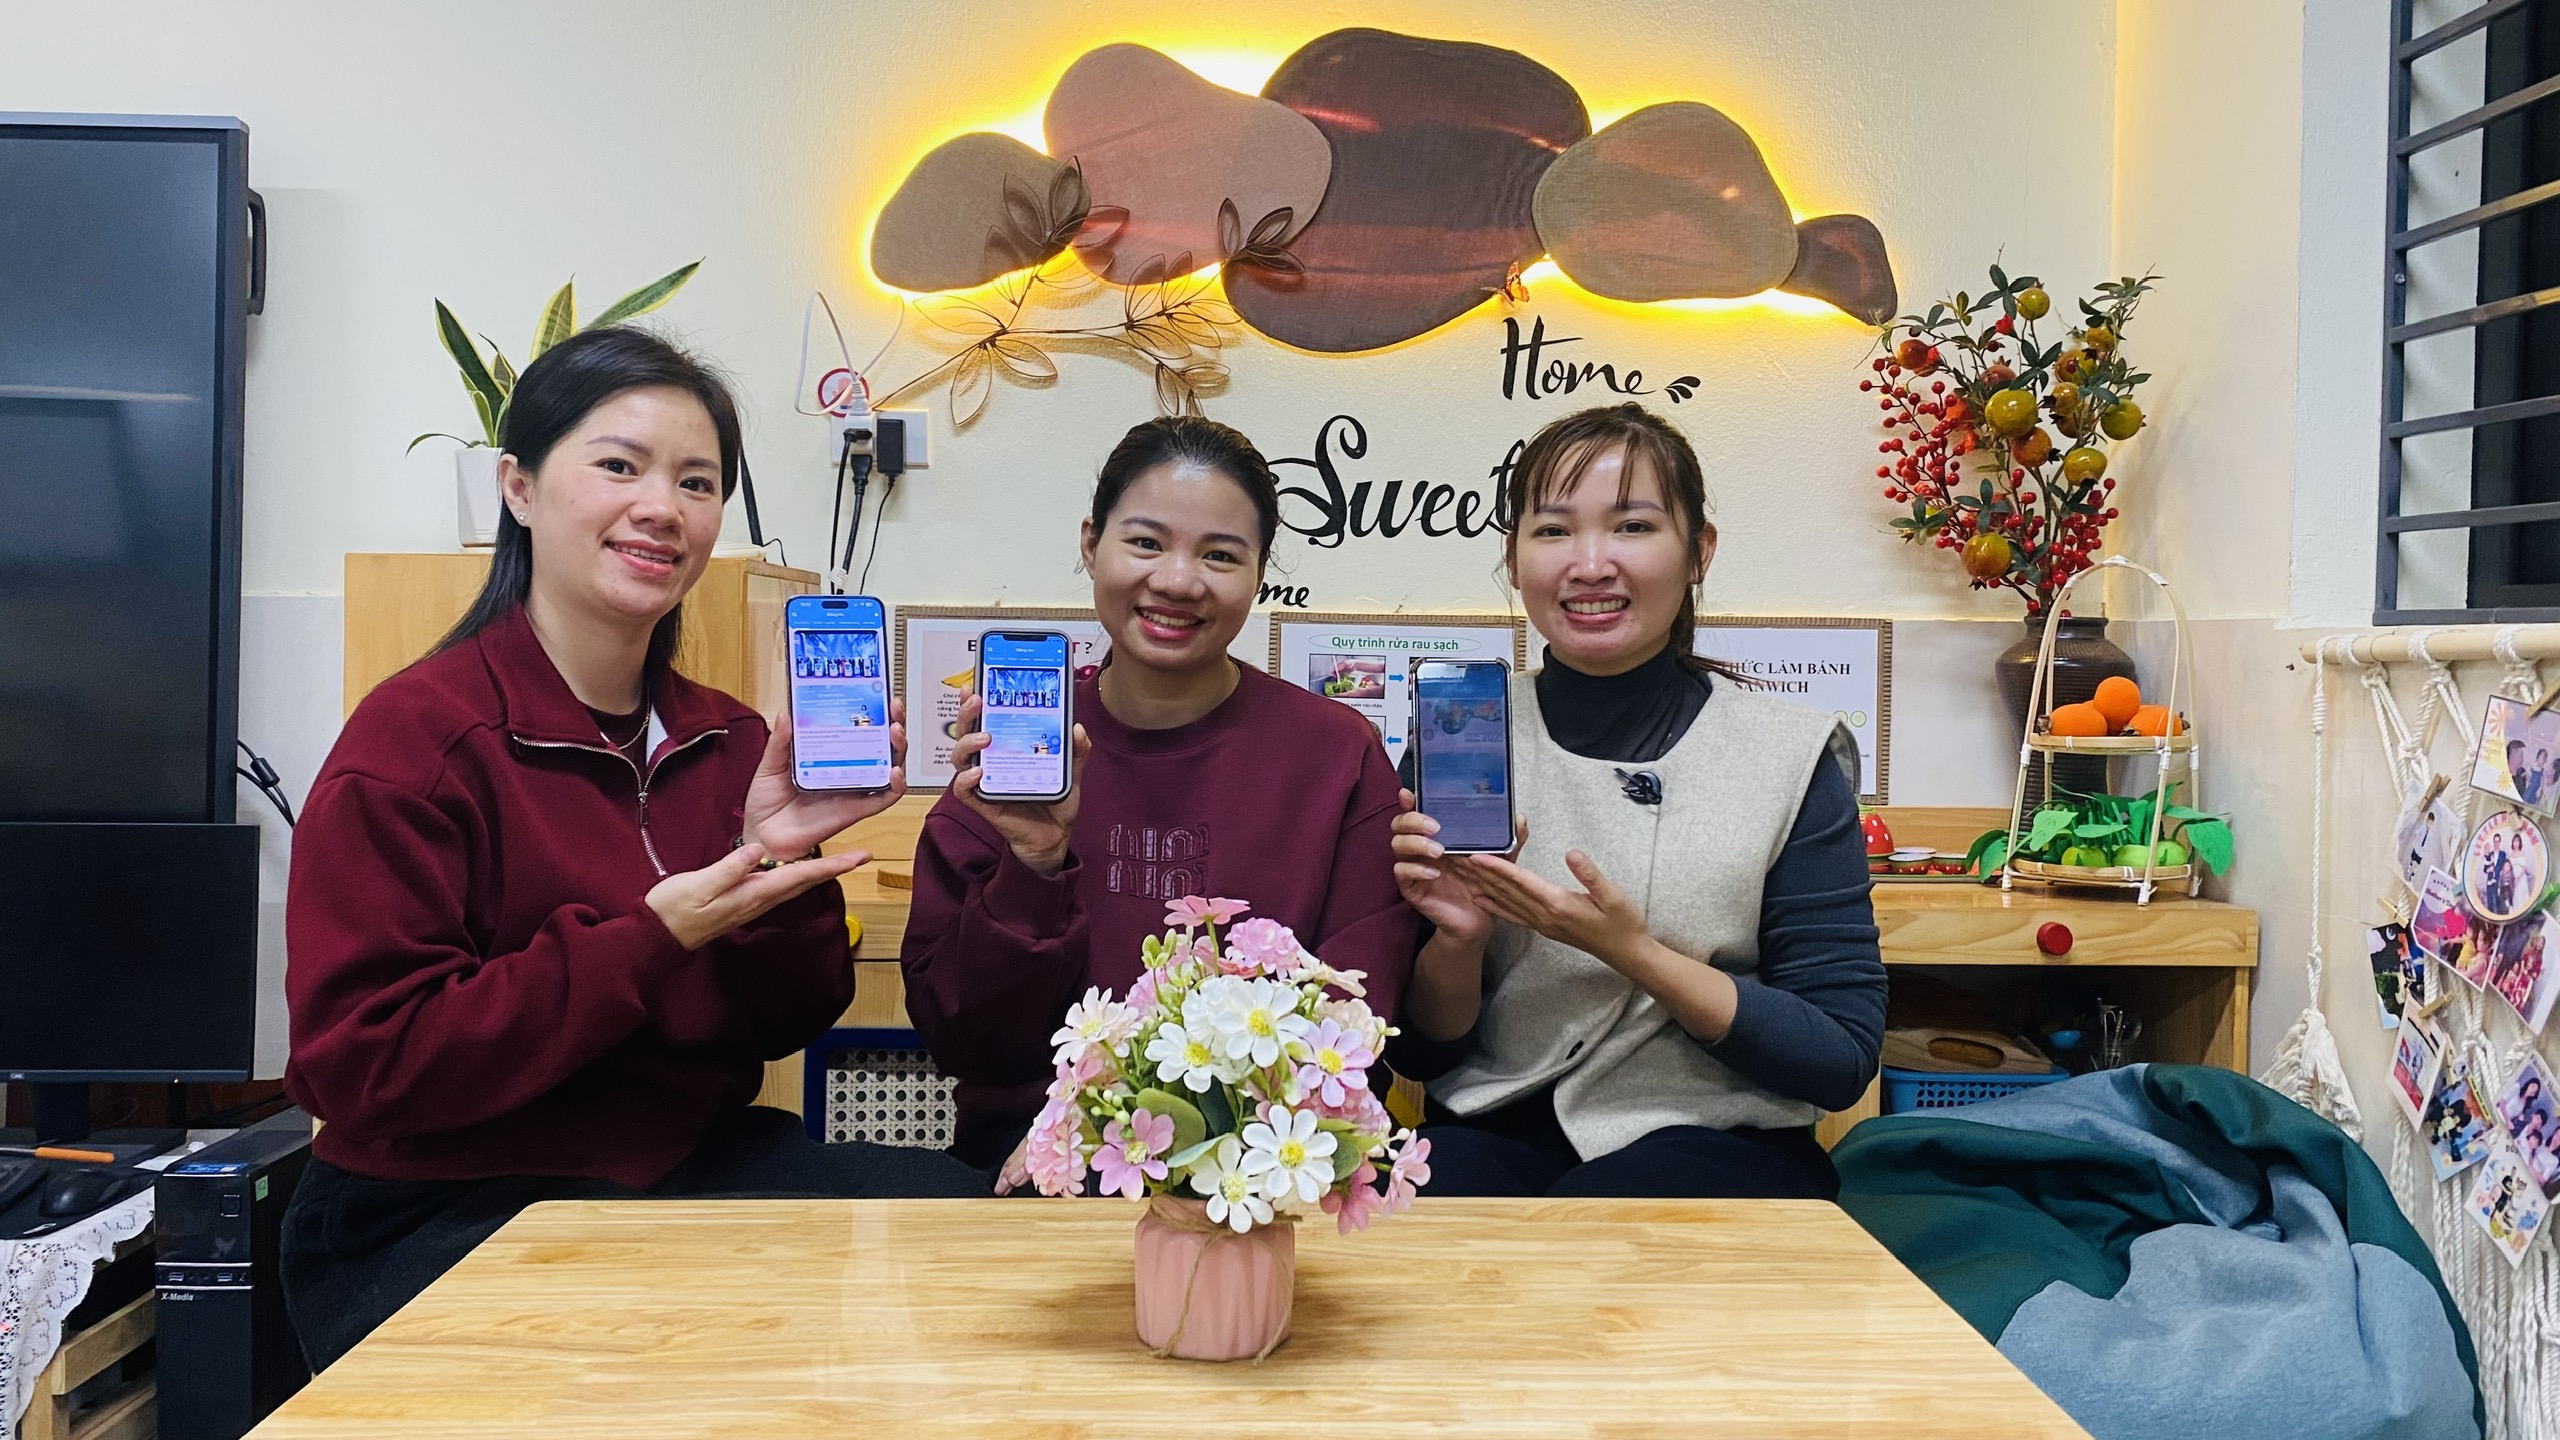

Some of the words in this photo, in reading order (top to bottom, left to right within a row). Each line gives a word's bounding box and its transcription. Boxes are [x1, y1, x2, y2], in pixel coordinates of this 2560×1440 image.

[1501, 315, 1657, 401] Home
[1268, 414, 1526, 549] Sweet
[1257, 582, 1310, 608] me
[1331, 637, 1356, 649] Quy
[1358, 637, 1385, 648] trình
[1388, 637, 1409, 649] rửa
[1412, 641, 1431, 649] rau
[1433, 640, 1459, 652] sạch
[1768, 660, 1802, 675] LÀM
[1807, 660, 1850, 675] BÁNH
[161, 1292, 195, 1301] X-Media
